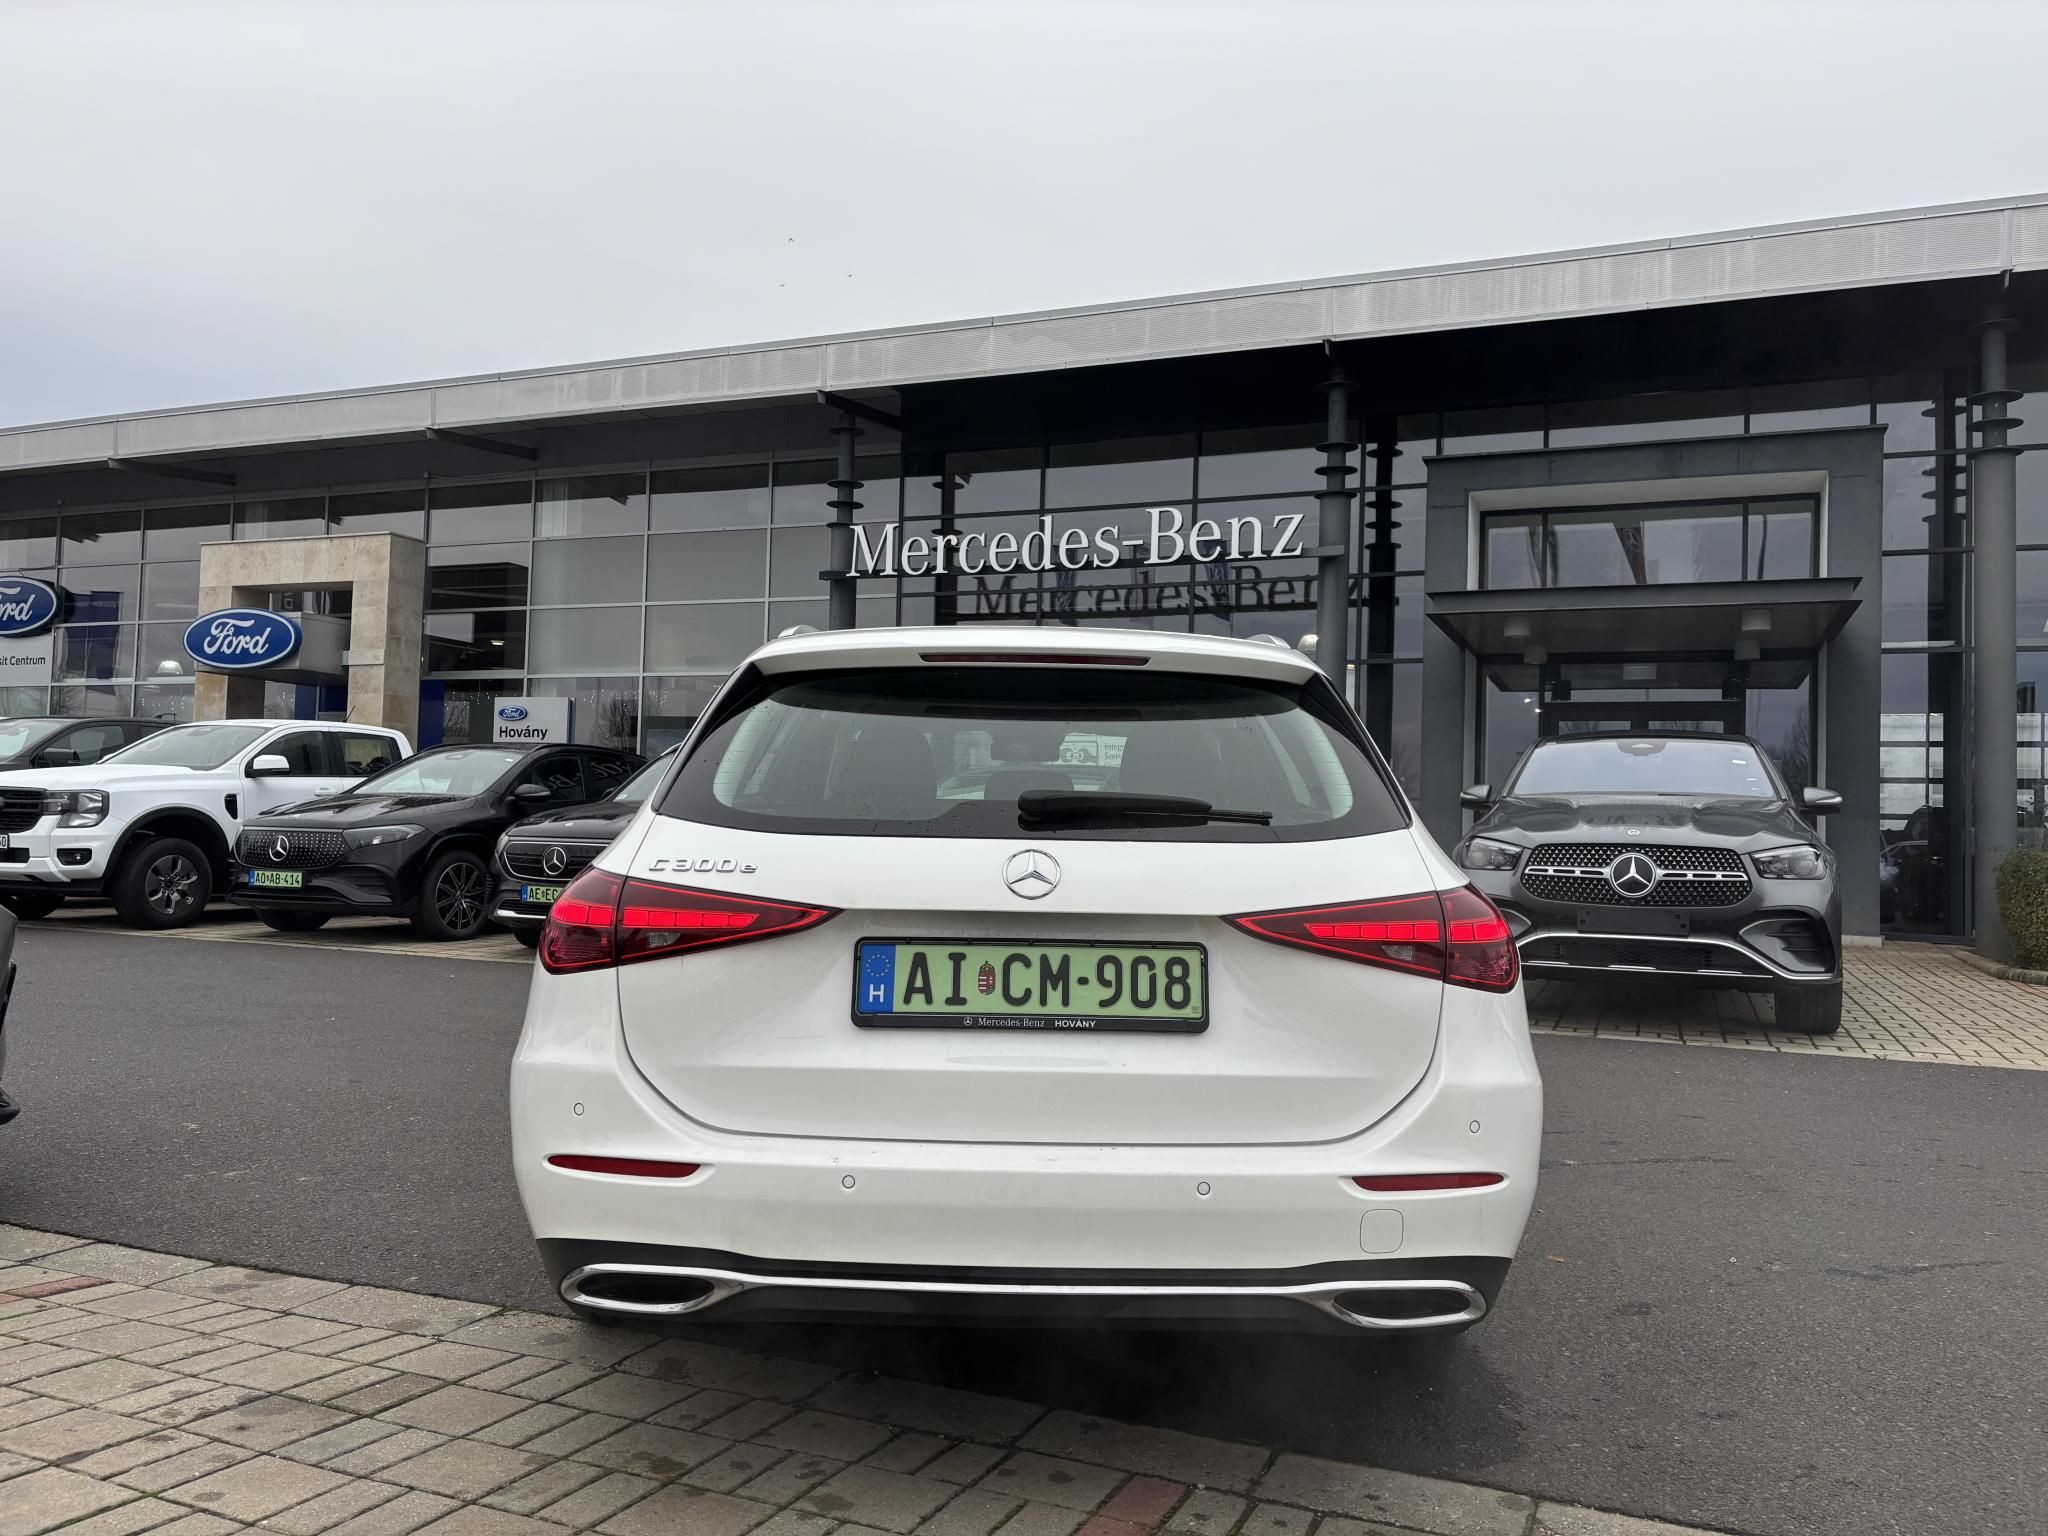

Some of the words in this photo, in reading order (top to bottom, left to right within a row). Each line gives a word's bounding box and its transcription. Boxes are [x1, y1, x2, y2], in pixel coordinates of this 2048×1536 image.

[846, 507, 1305, 577] Mercedes-Benz
[203, 618, 272, 655] Ford
[9, 656, 46, 666] Centrum
[499, 725, 548, 740] Hovány
[528, 887, 541, 900] AE
[903, 951, 968, 1006] AI
[1002, 953, 1192, 1010] CM-908
[868, 984, 885, 1003] H
[978, 1017, 1045, 1027] Mercedes-Benz
[1055, 1018, 1096, 1028] HOVÁNY
